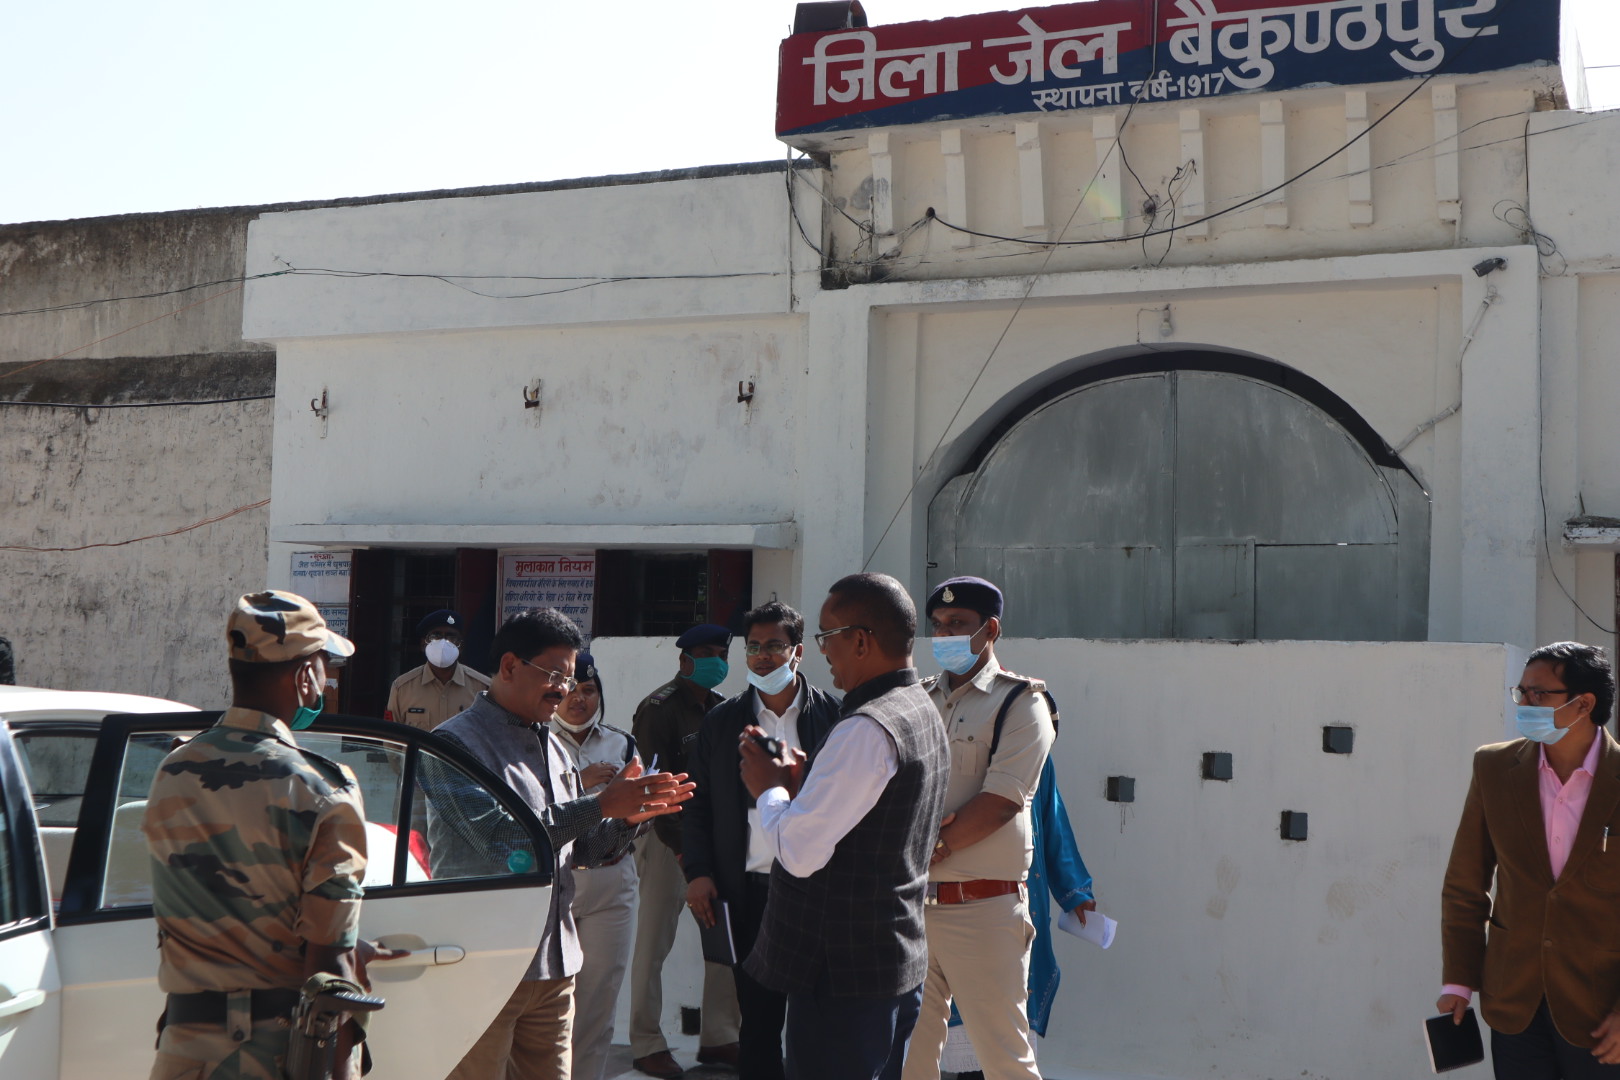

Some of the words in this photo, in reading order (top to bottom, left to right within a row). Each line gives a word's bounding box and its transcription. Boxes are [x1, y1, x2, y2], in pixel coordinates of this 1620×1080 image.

[803, 31, 971, 106] जिला
[983, 14, 1132, 86] जेल
[1031, 82, 1124, 112] स्थापना
[515, 560, 556, 577] मुलाकात
[558, 557, 594, 573] नियम
[557, 594, 563, 602] 15
